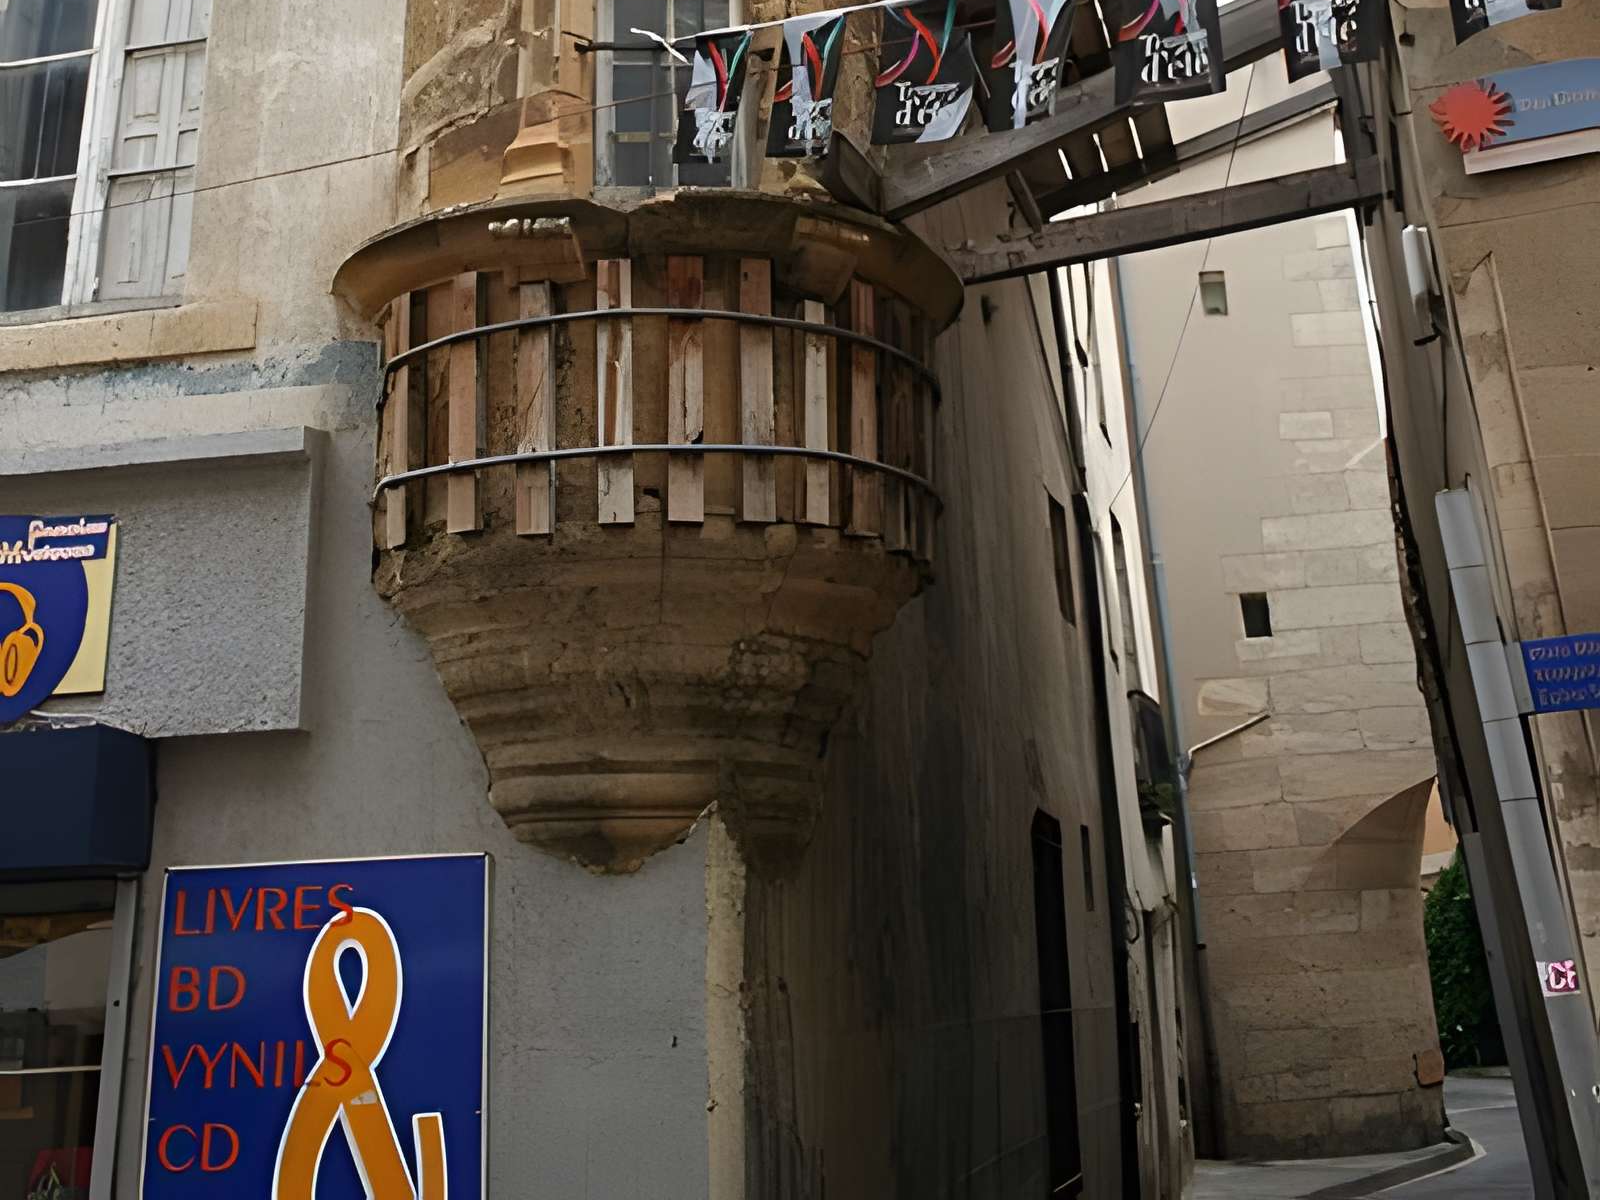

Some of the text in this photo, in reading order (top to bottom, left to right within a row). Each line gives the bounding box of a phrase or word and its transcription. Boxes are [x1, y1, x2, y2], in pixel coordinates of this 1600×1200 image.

[174, 882, 354, 936] LIVRES
[168, 965, 247, 1013] BD
[160, 1038, 353, 1089] VYNILS
[157, 1122, 240, 1173] CD
